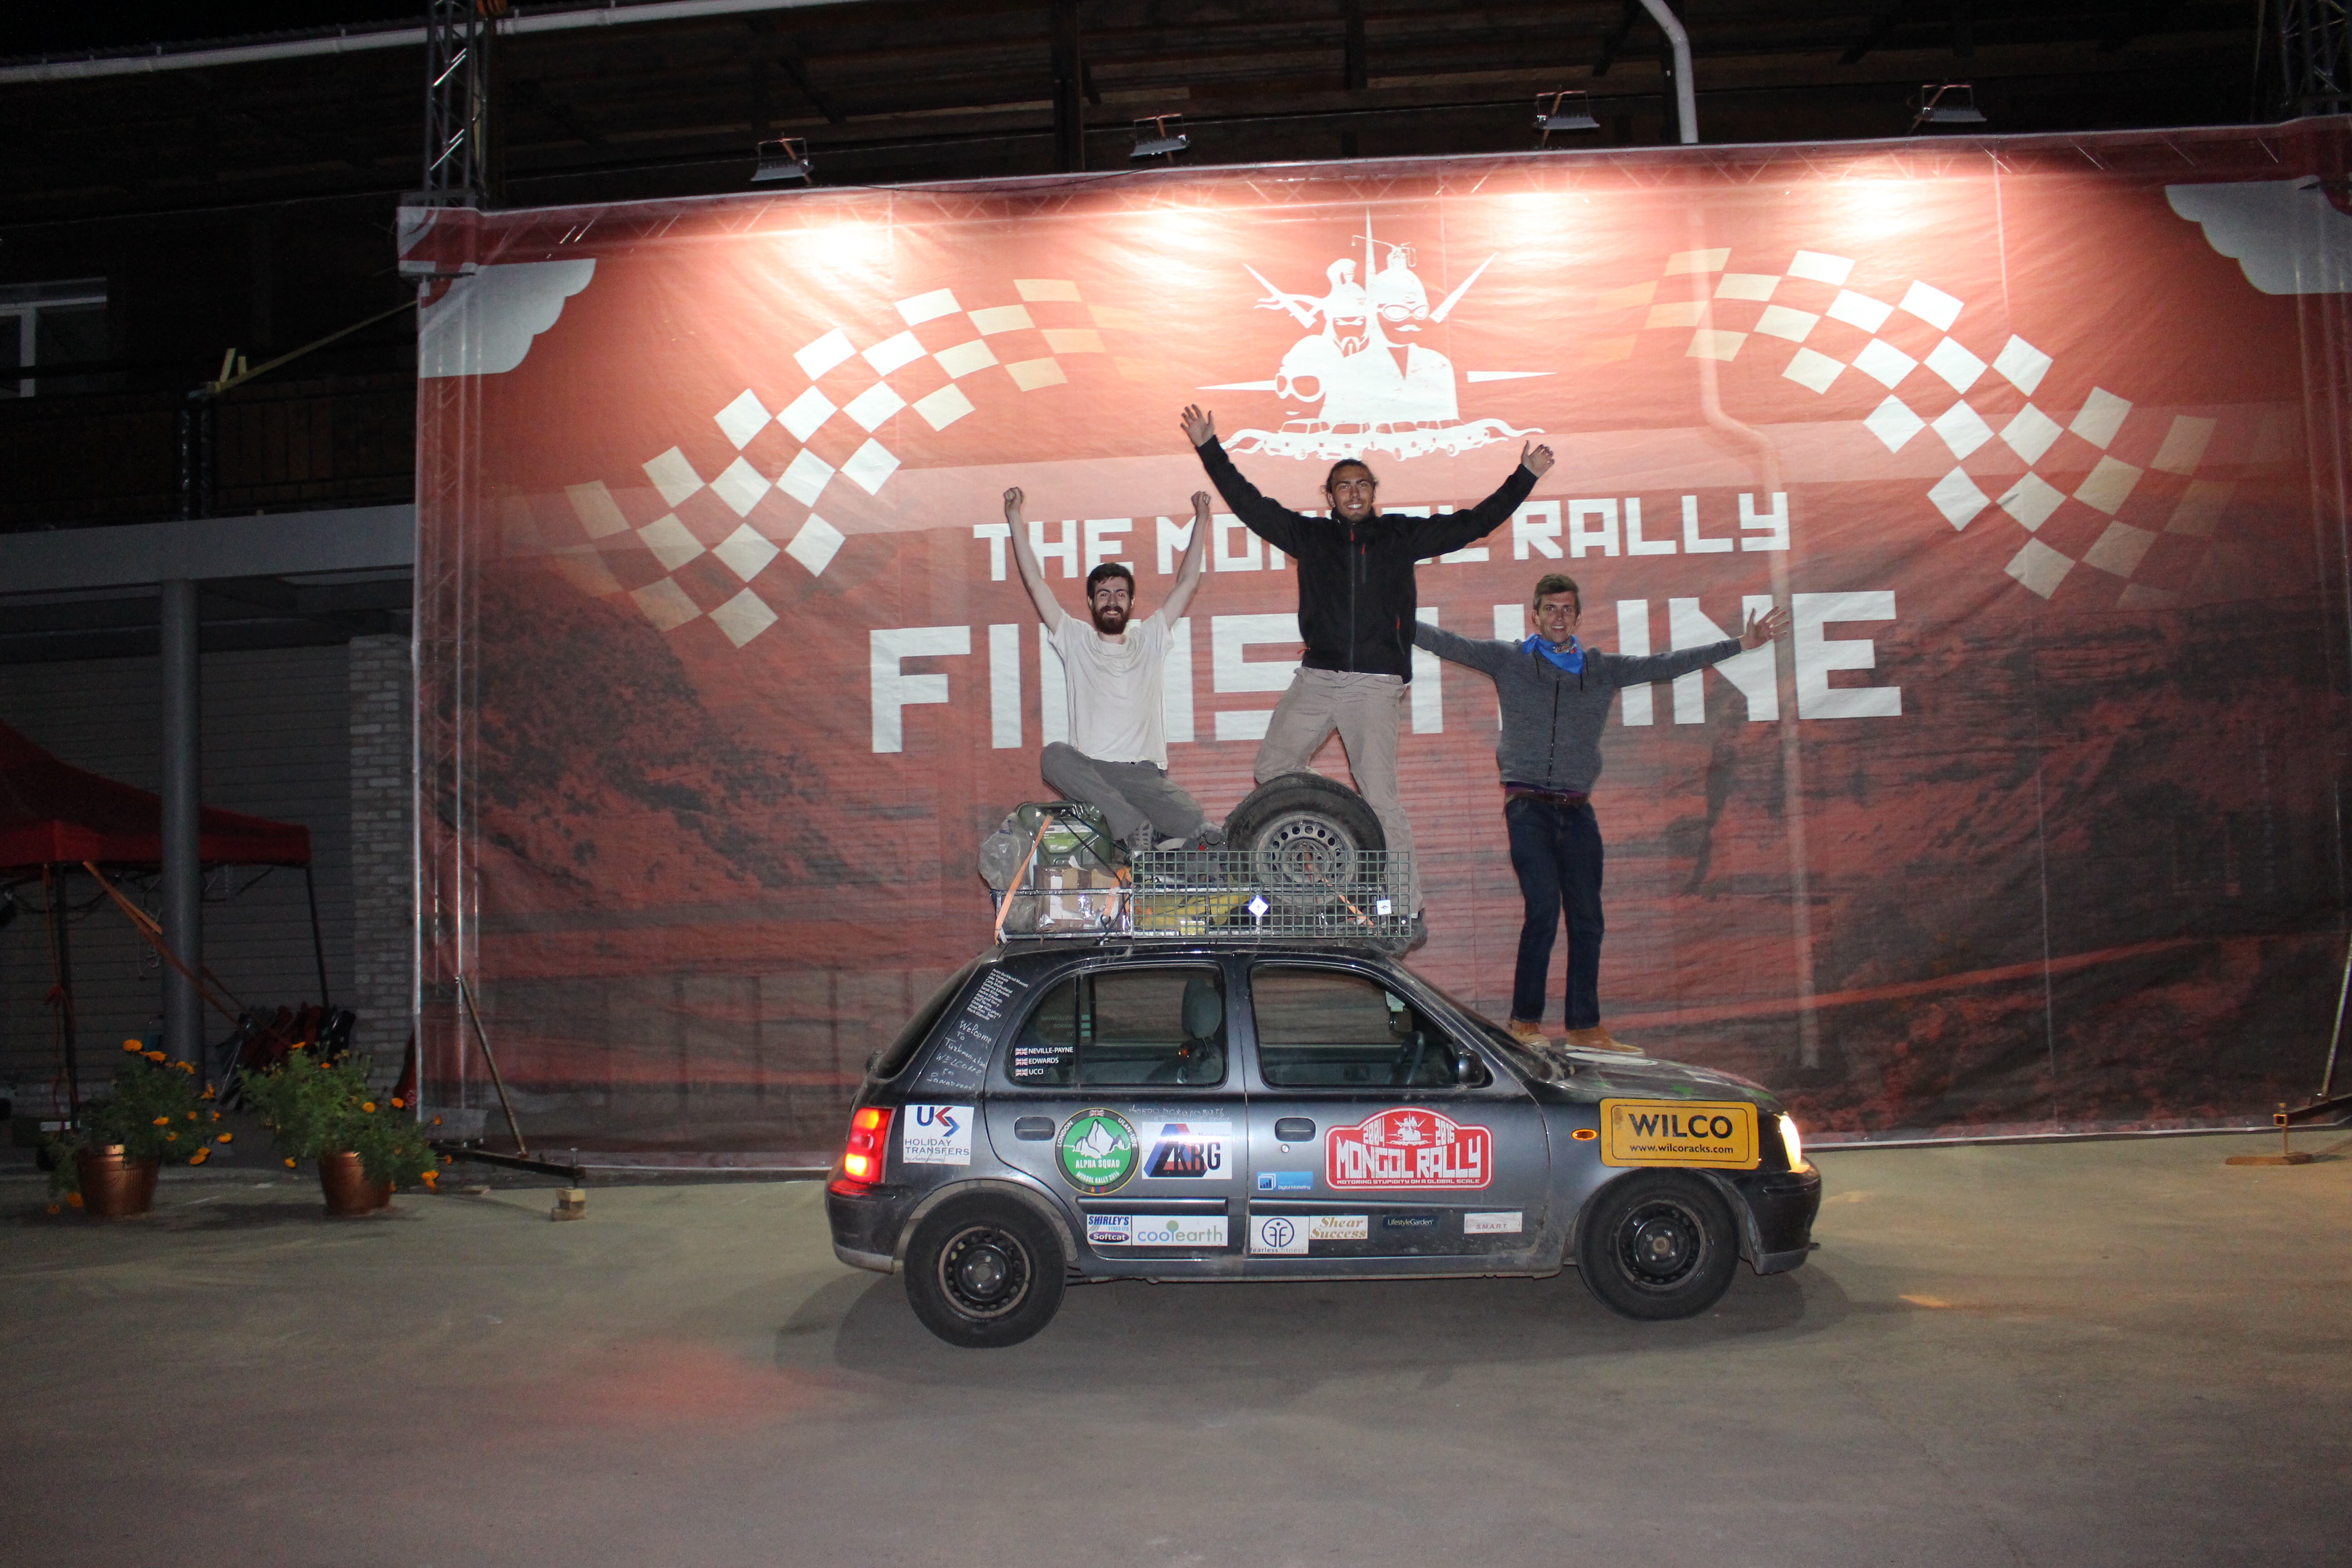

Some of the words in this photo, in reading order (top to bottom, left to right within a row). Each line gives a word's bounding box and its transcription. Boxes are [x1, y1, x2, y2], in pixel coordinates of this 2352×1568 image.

[973, 518, 1134, 581] THE
[1512, 492, 1790, 560] RALLY
[988, 993, 1003, 1003] Edwards
[996, 988, 1010, 998] Edwards
[960, 1020, 992, 1044] Welcome
[1028, 1046, 1073, 1054] NEVILLE-PAYNE
[916, 1106, 960, 1137] UK
[1628, 1113, 1733, 1139] WILCO
[1057, 1120, 1073, 1147] LONDON
[1118, 1117, 1137, 1148] ULAN-UDE
[1362, 1117, 1385, 1147] 2004
[1435, 1117, 1455, 1146] 2016
[905, 1147, 970, 1156] TRANSFERS
[1630, 1144, 1734, 1154] www.wilcoracks.com
[1336, 1135, 1414, 1179] MONGOL
[1416, 1135, 1482, 1179] RALLY
[1076, 1160, 1096, 1168] ALPHA
[1098, 1159, 1120, 1168] SQUAD
[1076, 1171, 1094, 1183] MONGOL
[1109, 1171, 1120, 1181] 2016
[1088, 1215, 1129, 1225] SHIRLEY'S
[1319, 1217, 1363, 1228] Shear
[1093, 1233, 1126, 1241] Softcat
[1310, 1228, 1367, 1239] Success
